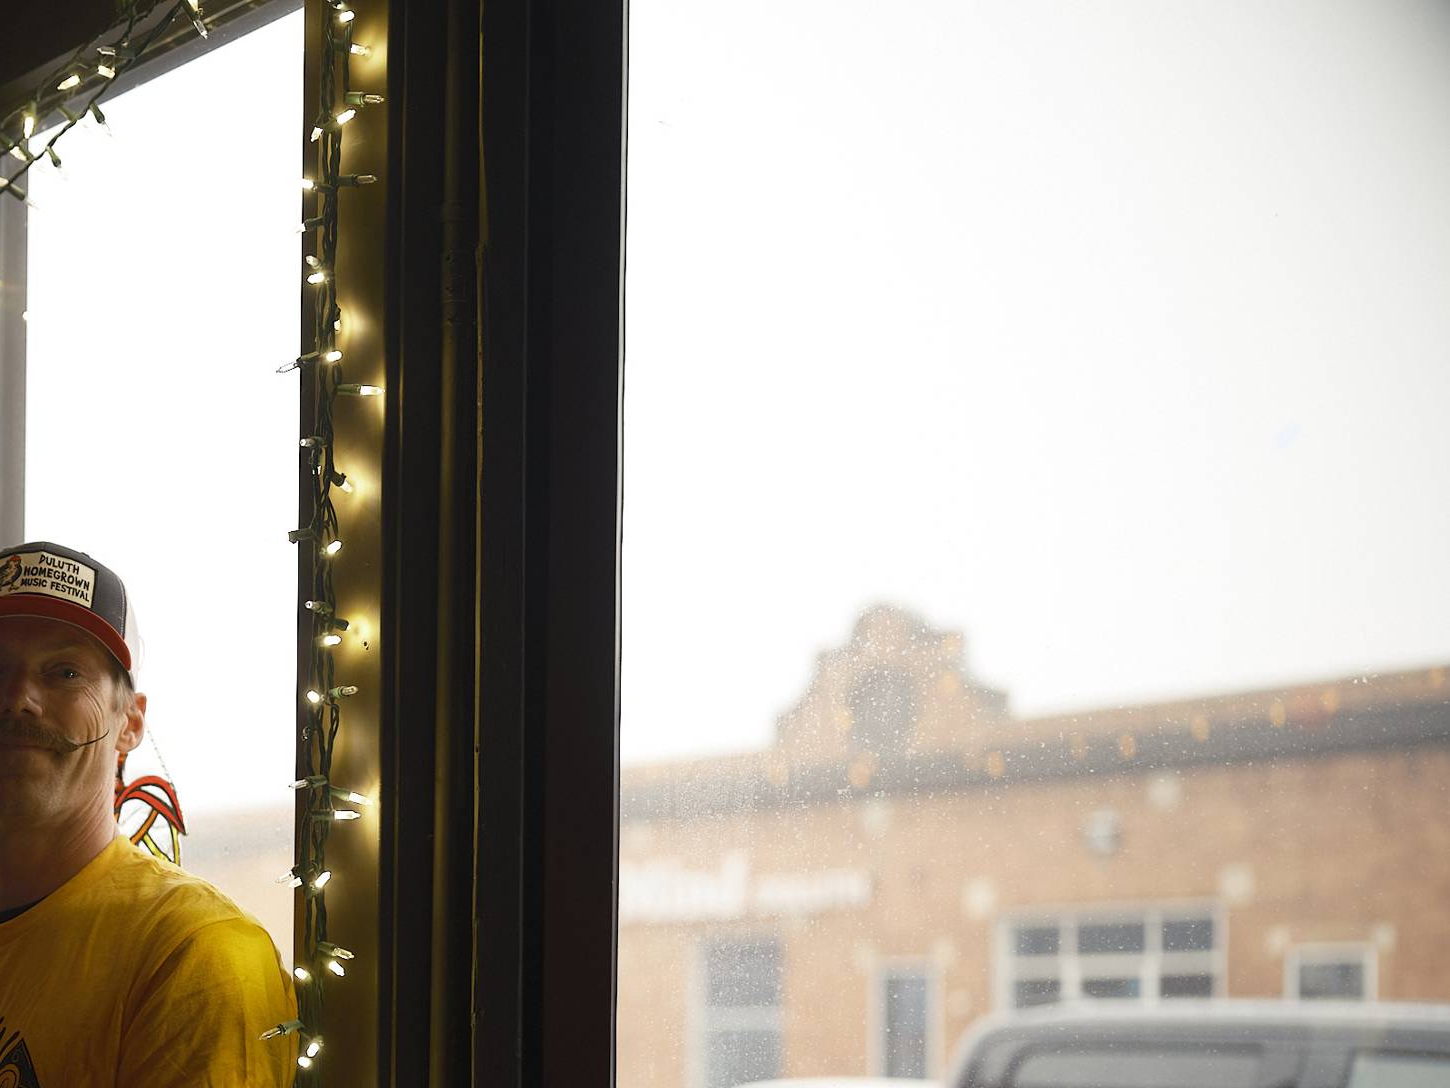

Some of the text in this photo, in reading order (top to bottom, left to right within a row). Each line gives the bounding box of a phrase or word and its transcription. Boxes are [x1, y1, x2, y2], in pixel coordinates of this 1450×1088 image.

[39, 554, 80, 575] DULUTH
[24, 564, 91, 591] HOMEGROWN
[21, 578, 90, 602] MUSIC FESTIVAL
